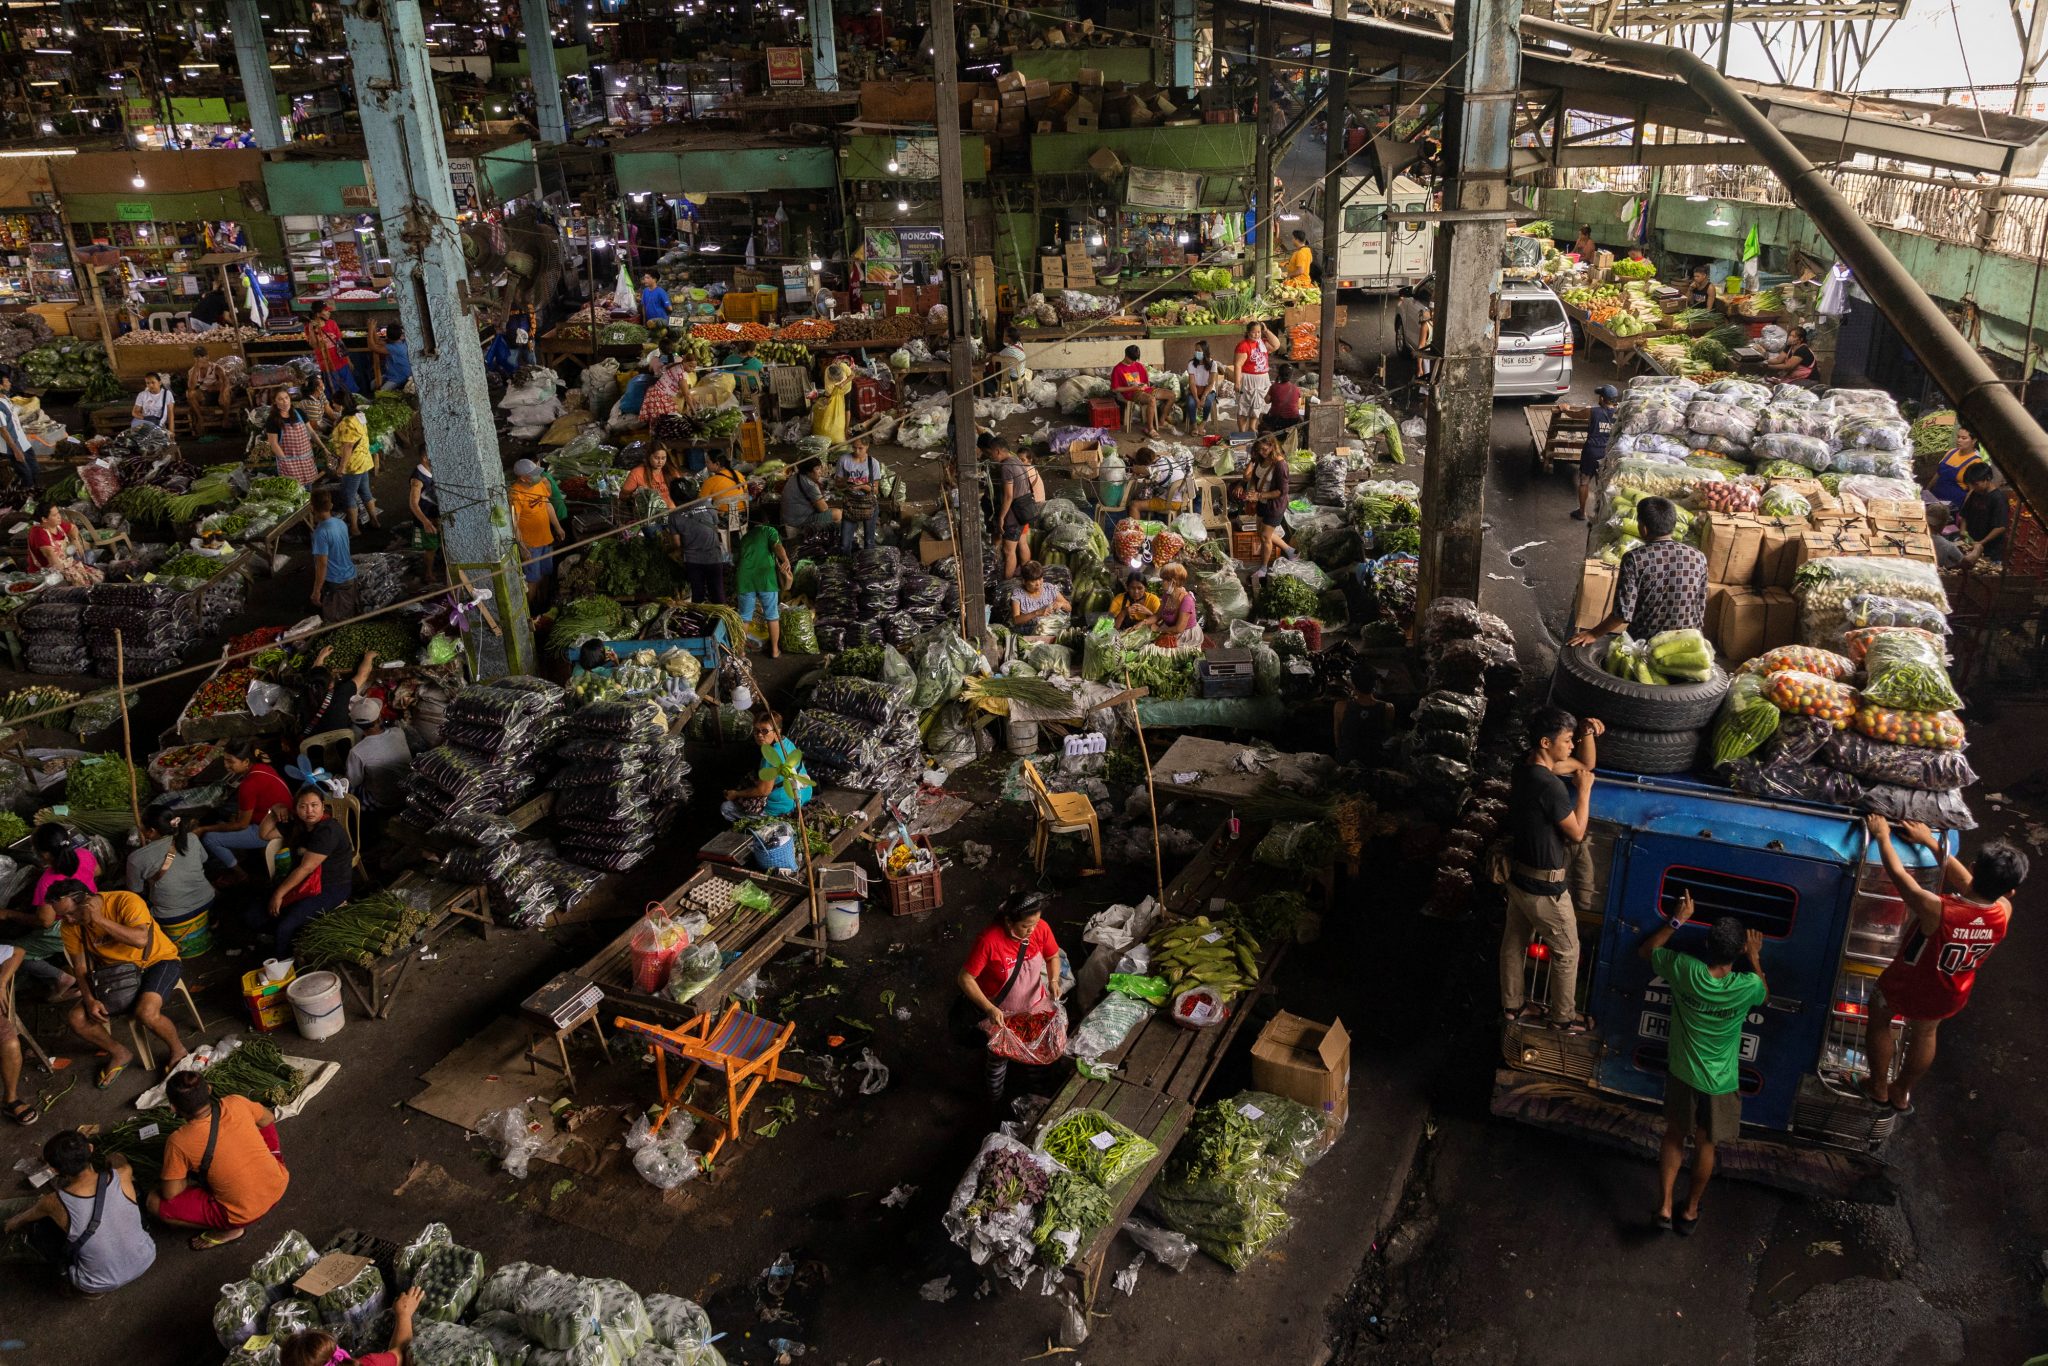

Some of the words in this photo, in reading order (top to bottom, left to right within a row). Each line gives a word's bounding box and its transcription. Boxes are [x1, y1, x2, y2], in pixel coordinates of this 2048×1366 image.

[1952, 927, 1969, 940] STA
[1969, 928, 1994, 940] LUCIA
[1936, 942, 1996, 976] 07
